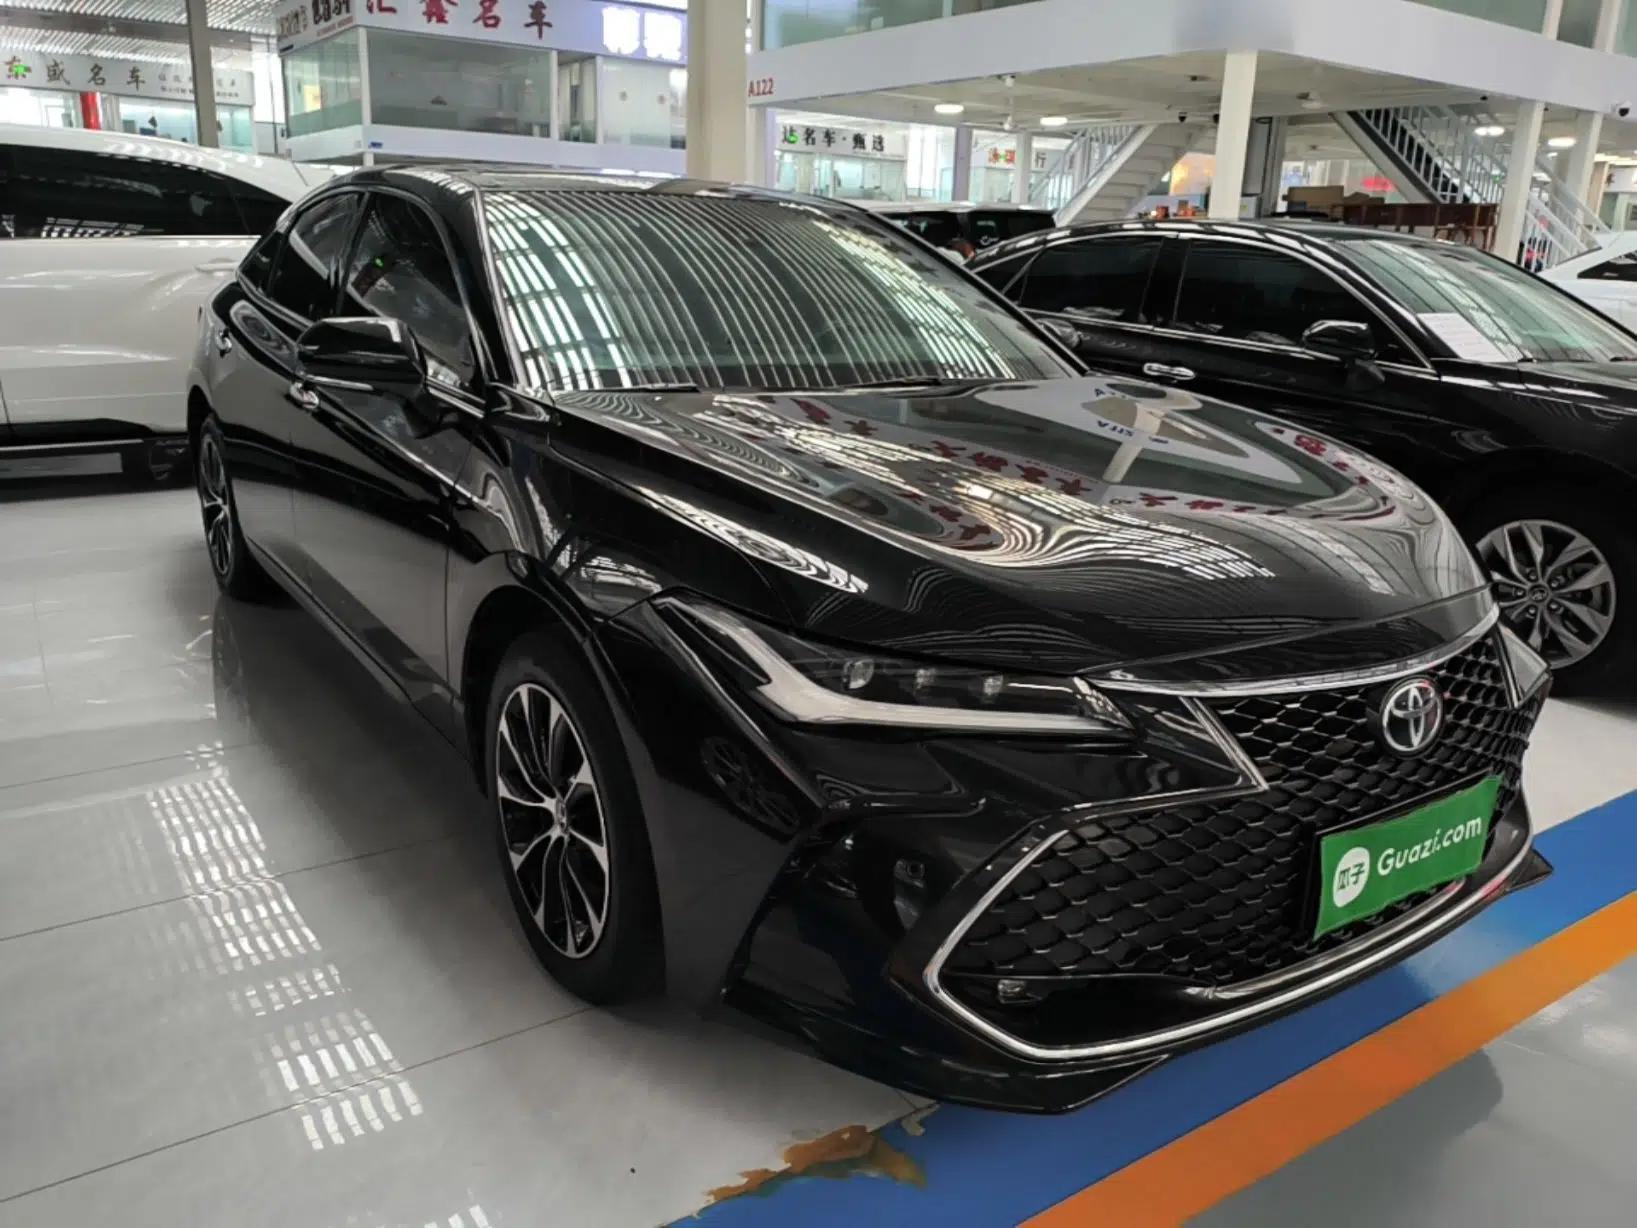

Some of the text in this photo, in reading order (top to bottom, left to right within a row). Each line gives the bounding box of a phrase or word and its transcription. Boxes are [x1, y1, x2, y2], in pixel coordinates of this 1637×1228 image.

[748, 78, 774, 97] A122
[1377, 816, 1482, 876] Guazi.com
[1336, 862, 1366, 891] 瓜子
